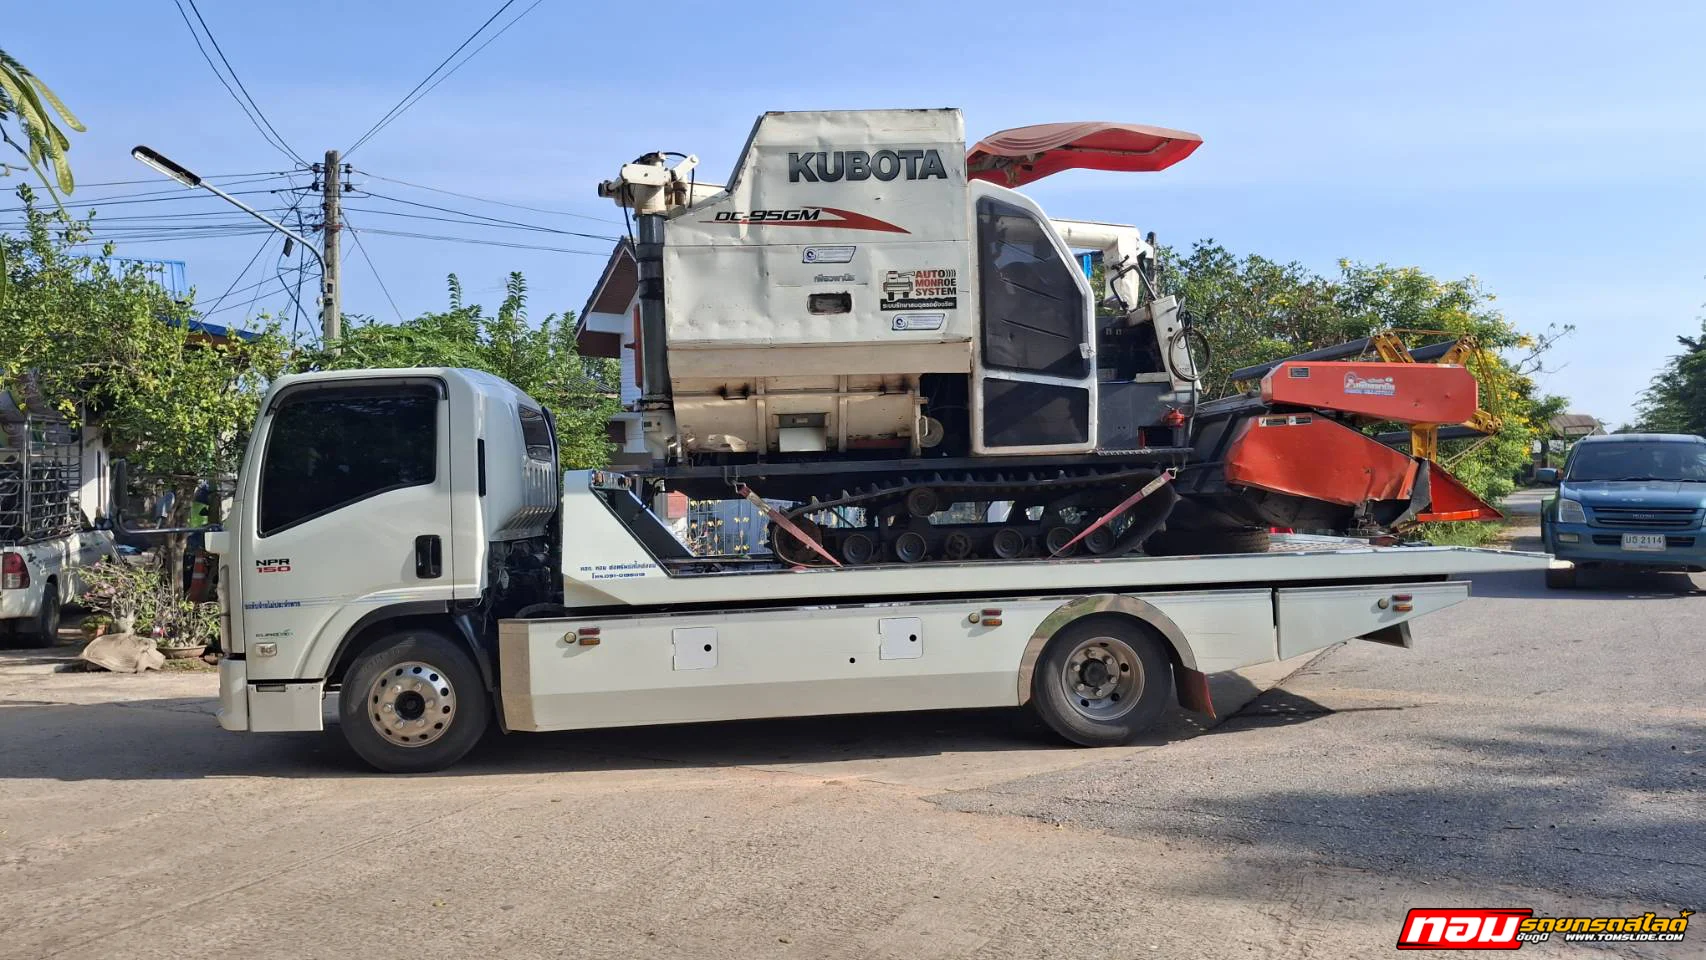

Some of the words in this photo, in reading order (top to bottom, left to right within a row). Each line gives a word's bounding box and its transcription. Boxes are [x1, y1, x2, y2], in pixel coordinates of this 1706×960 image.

[788, 149, 947, 183] KUBOTA
[715, 209, 821, 221] DC-95GM
[915, 269, 946, 279] AUTO
[915, 278, 957, 287] MONROE
[915, 287, 957, 296] SYSTEM
[1640, 536, 1662, 545] 2114
[256, 558, 290, 566] NPR
